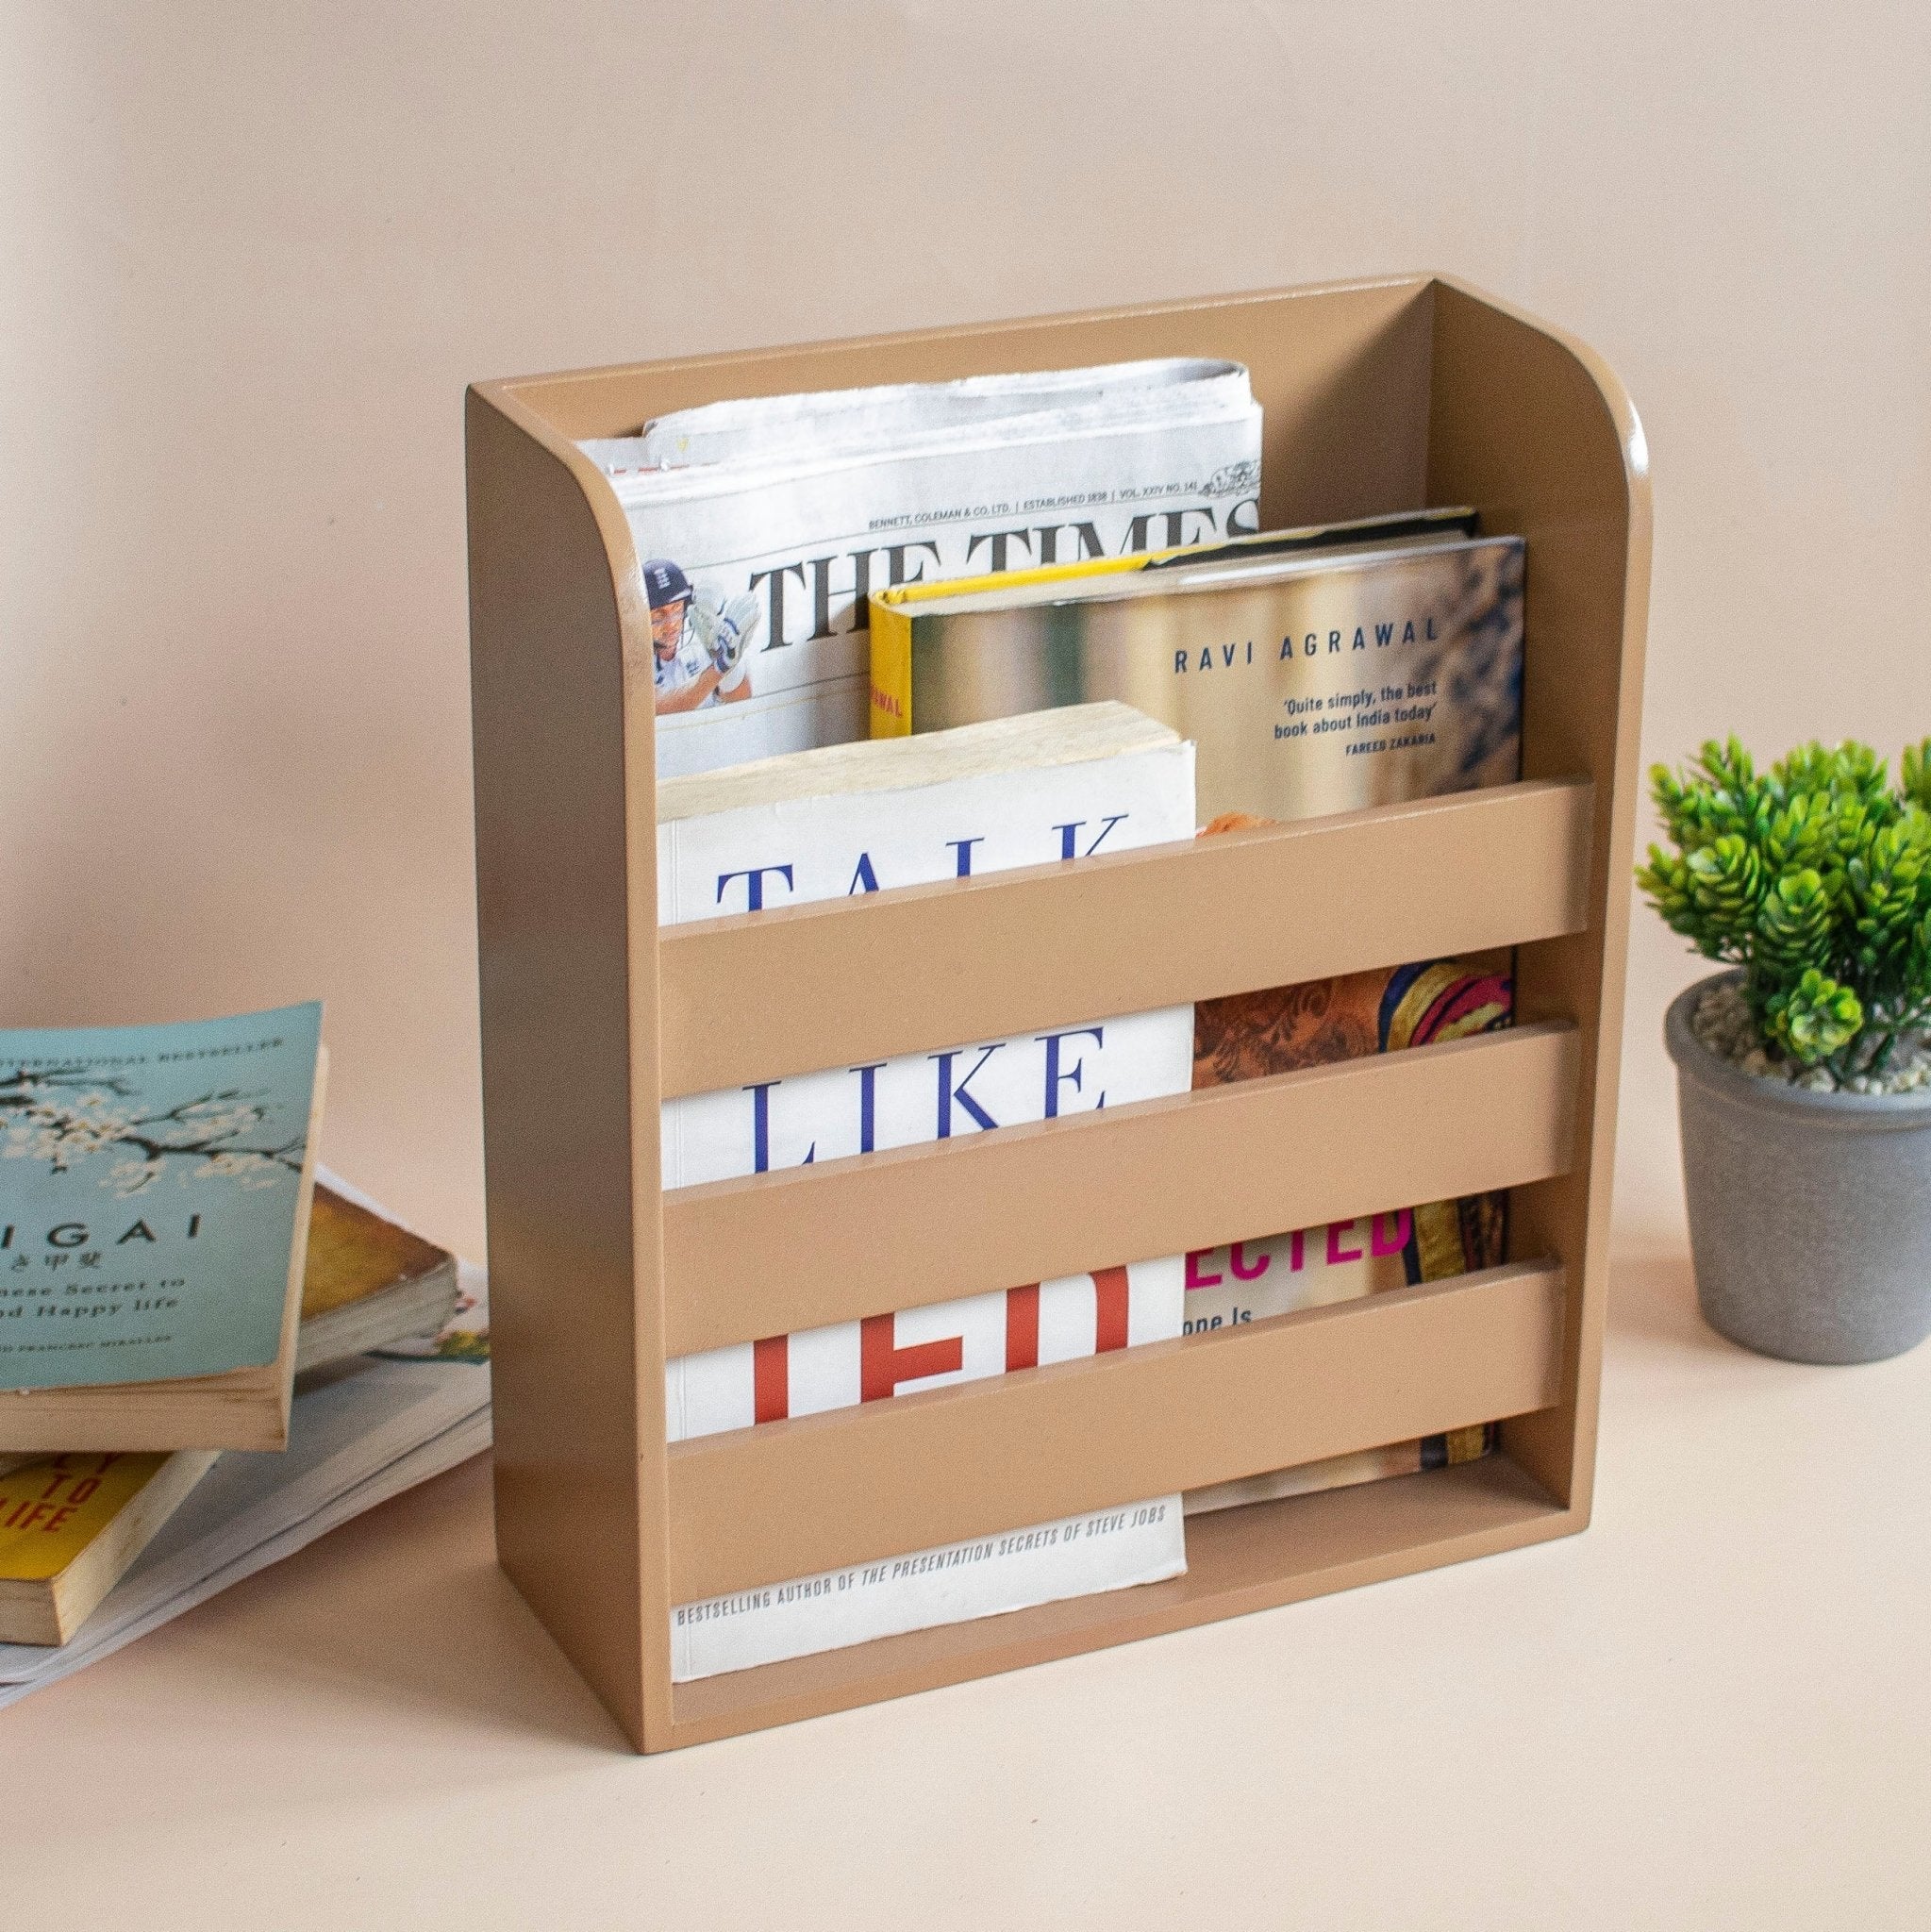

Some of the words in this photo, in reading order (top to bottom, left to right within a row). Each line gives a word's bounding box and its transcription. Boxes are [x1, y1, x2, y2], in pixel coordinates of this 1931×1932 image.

[915, 509, 961, 523] COLEMAN
[964, 507, 971, 516] &
[1024, 494, 1084, 510] ESTABLISHED
[1088, 491, 1107, 503] 1838
[748, 541, 941, 653] THE
[1174, 641, 1253, 674] RAVI
[1280, 618, 1438, 660] AGRAWAL
[1328, 690, 1375, 708] simply,
[1381, 686, 1403, 702] the
[1407, 681, 1437, 697] best
[1274, 722, 1307, 740] book
[1313, 716, 1351, 733] about
[1357, 709, 1390, 726] India
[1346, 740, 1386, 756] FAREED
[1390, 733, 1435, 750] ZAKARIA
[741, 1026, 1106, 1174] LIKE
[66, 1280, 146, 1297] Secret
[159, 1277, 185, 1290] to
[36, 1303, 122, 1320] Happy
[42, 1474, 102, 1506] TO
[677, 1591, 771, 1626] BESTSELLING
[777, 1578, 831, 1605] AUTHOR
[839, 1573, 855, 1591] OF
[862, 1566, 888, 1586] THE
[892, 1541, 994, 1579] PRESENTATION
[998, 1527, 1058, 1557] SECRETS
[1063, 1523, 1082, 1542] OF
[1086, 1513, 1125, 1538] STEVE
[1130, 1505, 1166, 1528] JOBS
